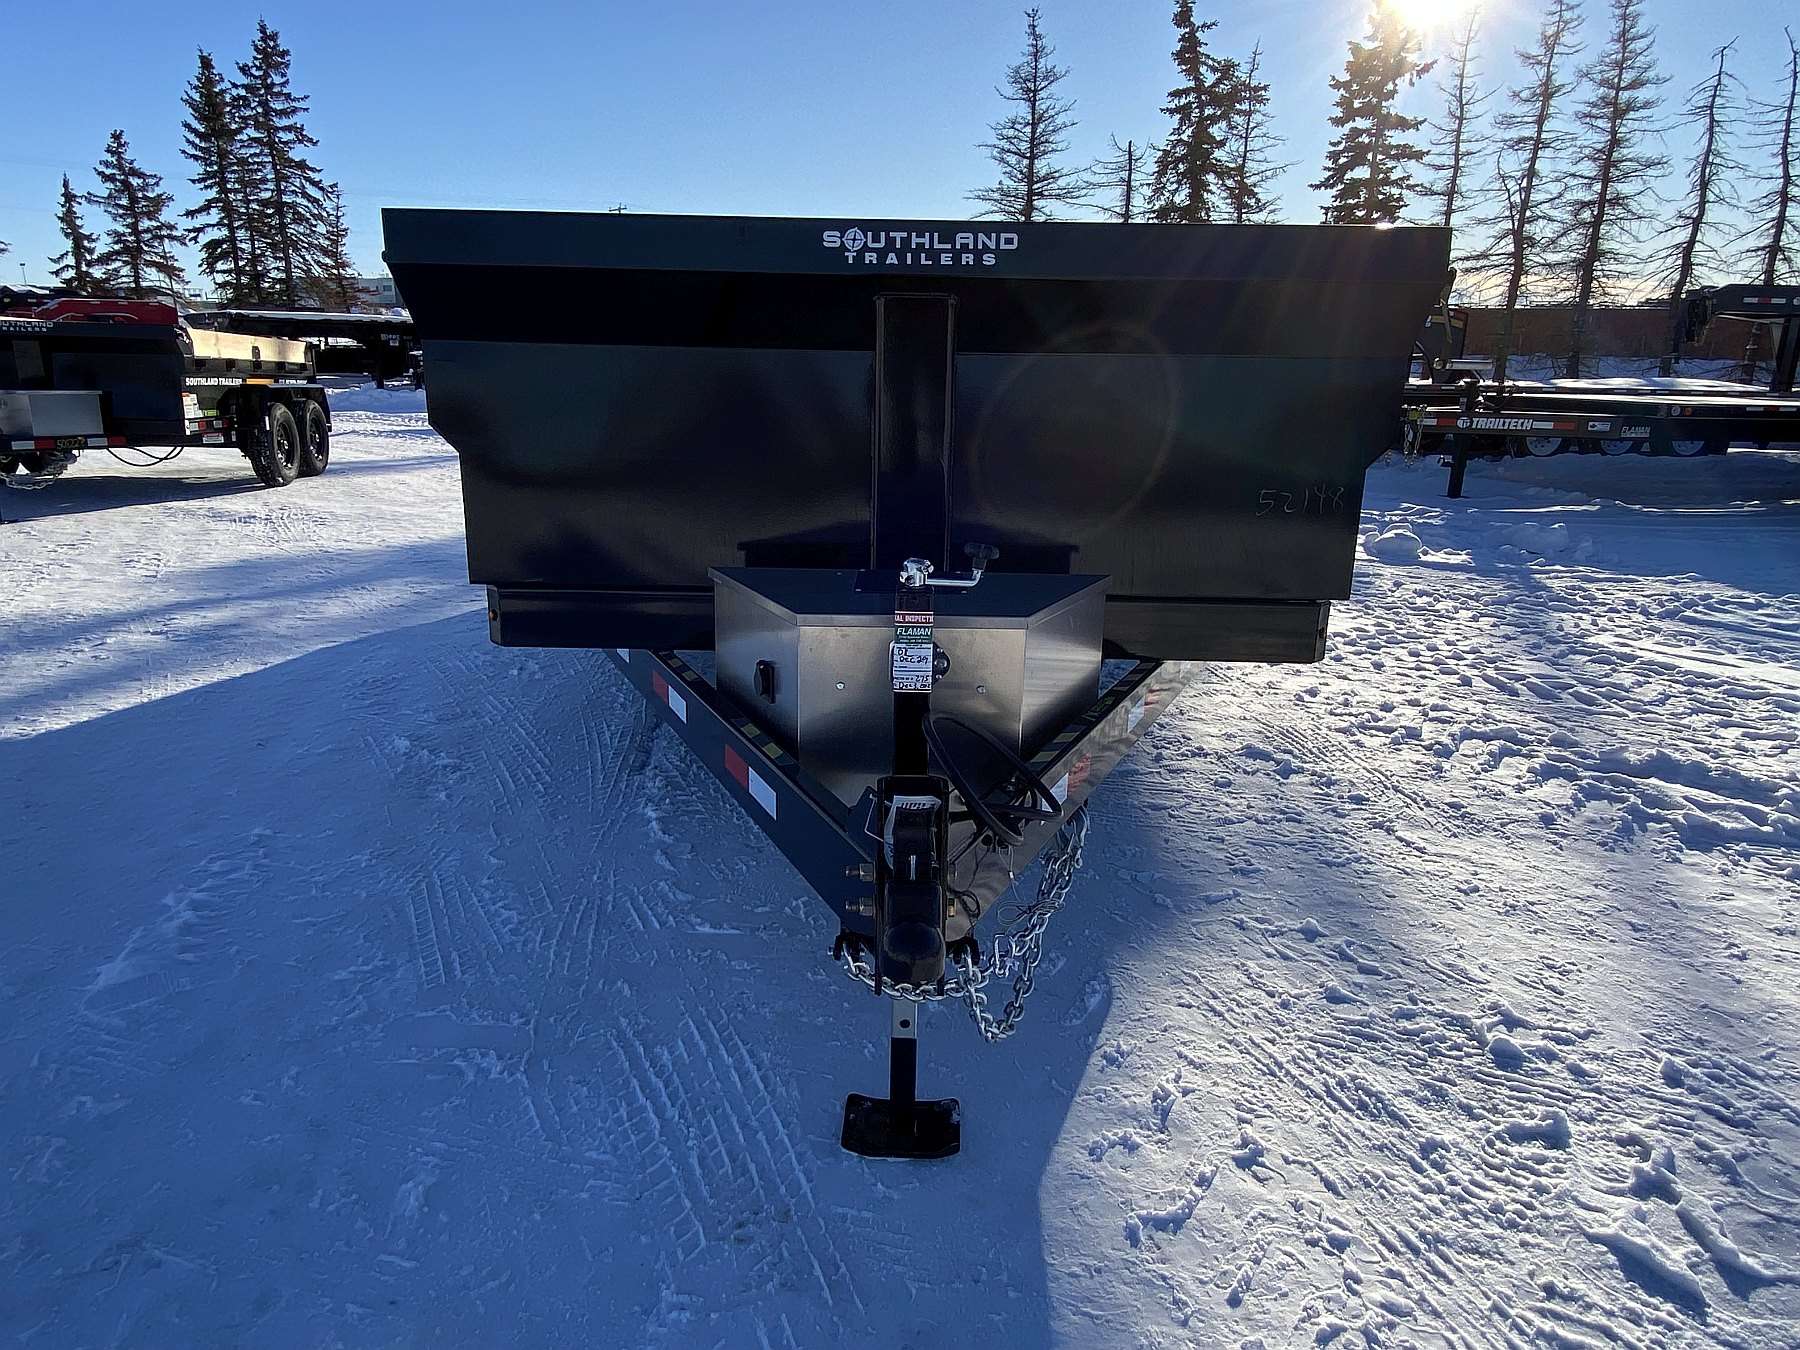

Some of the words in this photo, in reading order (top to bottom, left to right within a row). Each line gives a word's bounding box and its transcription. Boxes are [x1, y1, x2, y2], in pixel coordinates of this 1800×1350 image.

[822, 227, 1019, 251] SOUTHLAND
[844, 251, 996, 266] TRAILERS
[185, 377, 219, 386] SOUTHLAND
[1471, 417, 1533, 430] TRAILTECH
[896, 627, 932, 636] FLAMAN
